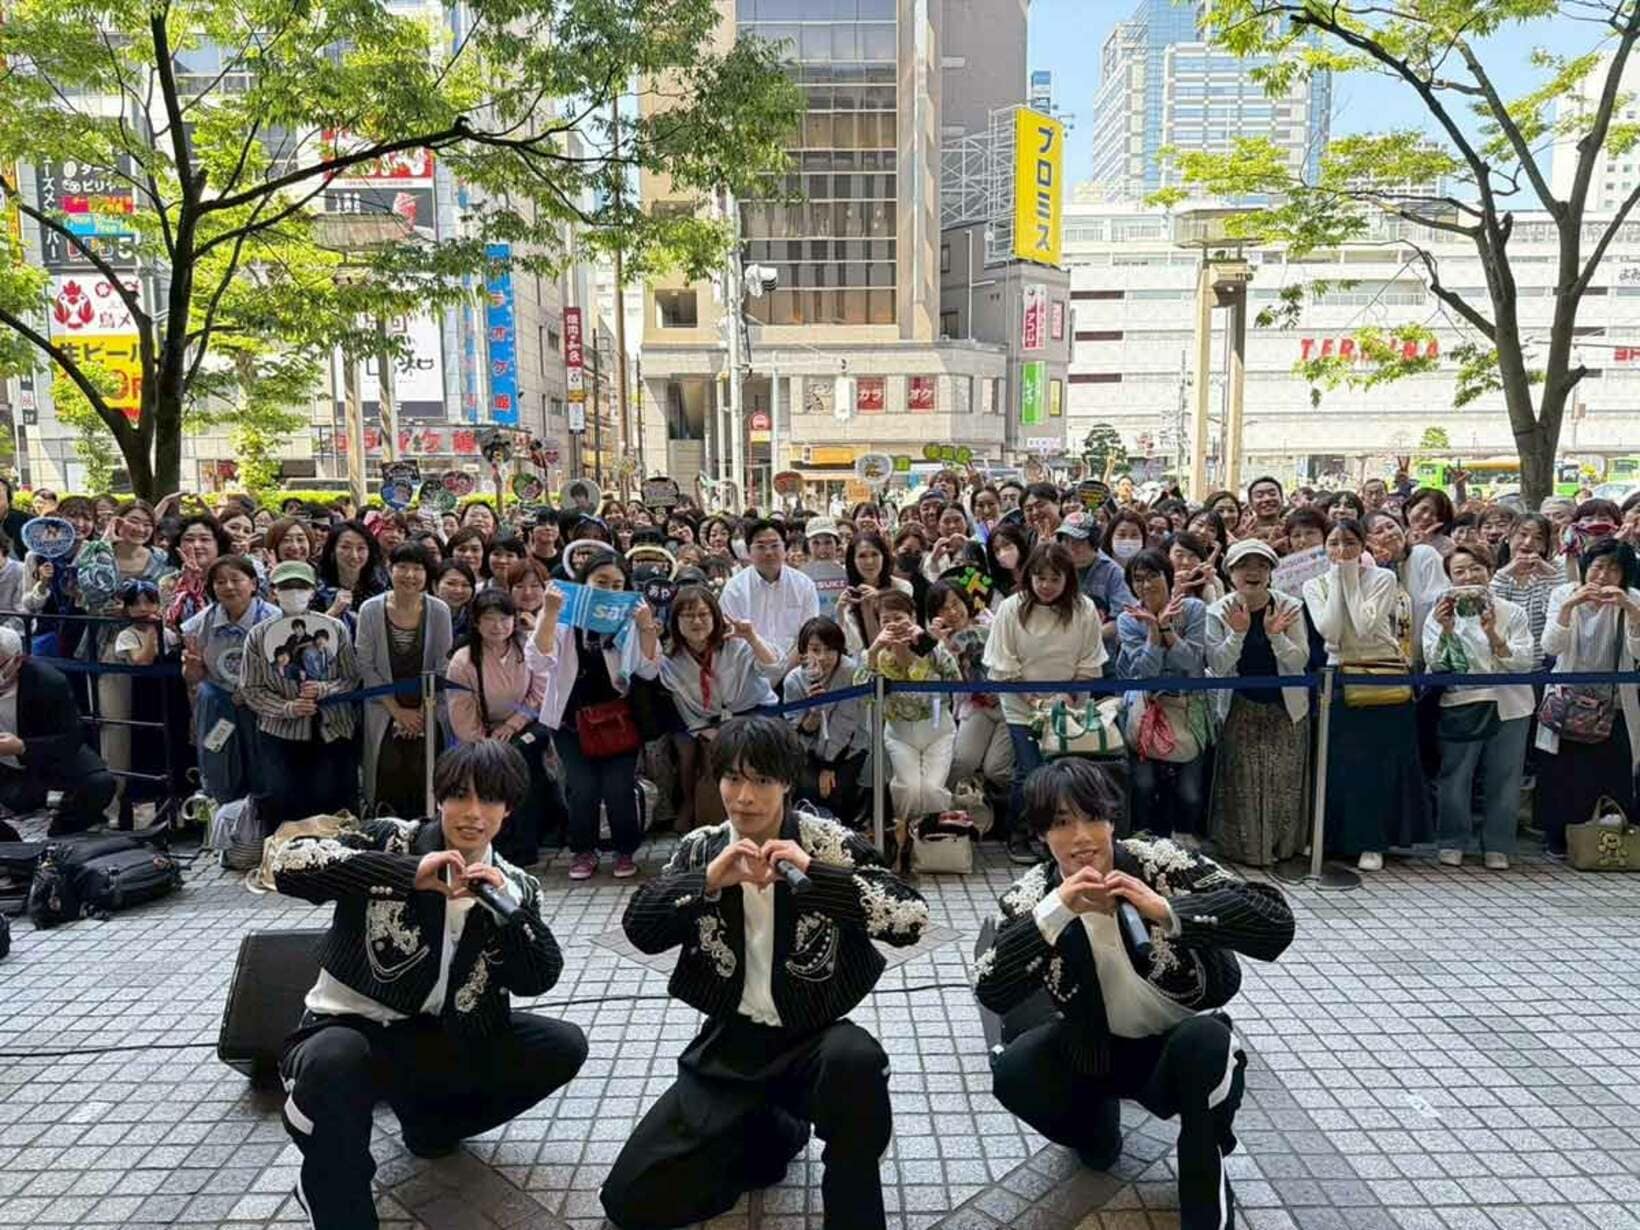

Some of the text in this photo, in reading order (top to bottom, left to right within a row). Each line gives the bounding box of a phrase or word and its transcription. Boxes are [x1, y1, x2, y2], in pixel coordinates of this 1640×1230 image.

[1036, 126, 1055, 251] プロミス
[858, 388, 882, 402] カラ
